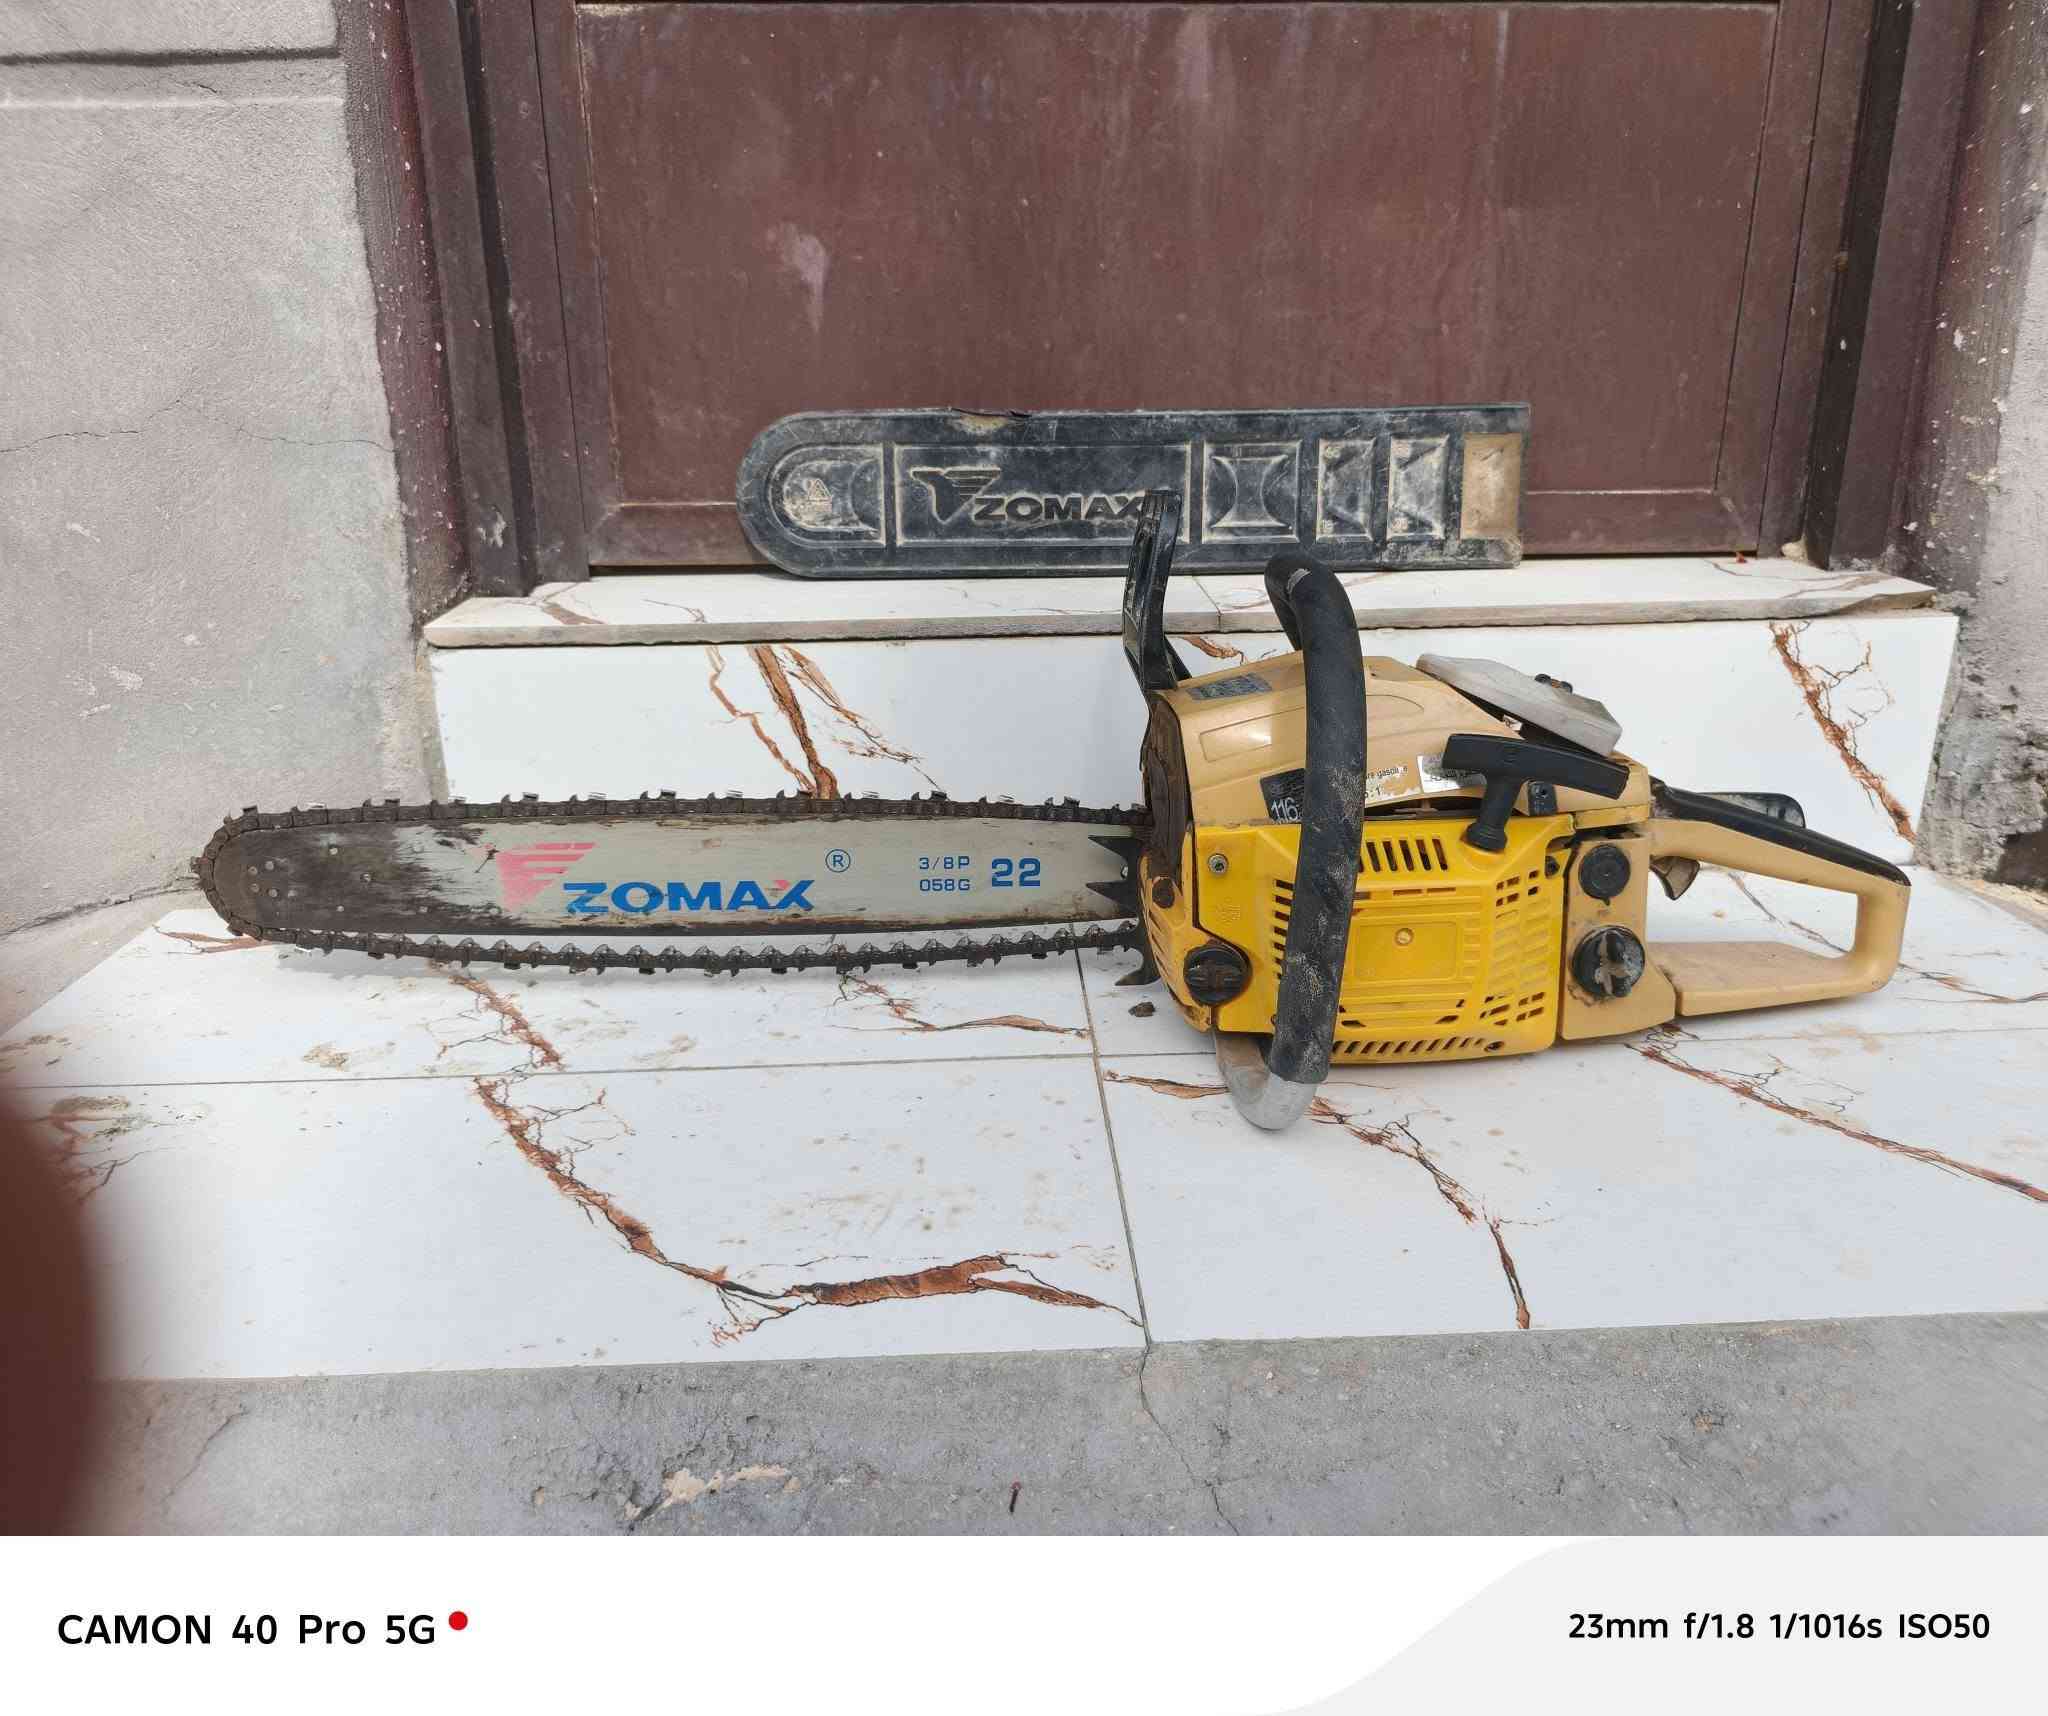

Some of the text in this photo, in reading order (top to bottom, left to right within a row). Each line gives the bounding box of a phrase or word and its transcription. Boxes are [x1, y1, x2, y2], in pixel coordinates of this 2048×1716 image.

[971, 494, 1145, 522] ZOMAX
[919, 856, 970, 871] 3/8P
[991, 857, 1041, 887] 22
[563, 879, 814, 914] ZOMAX
